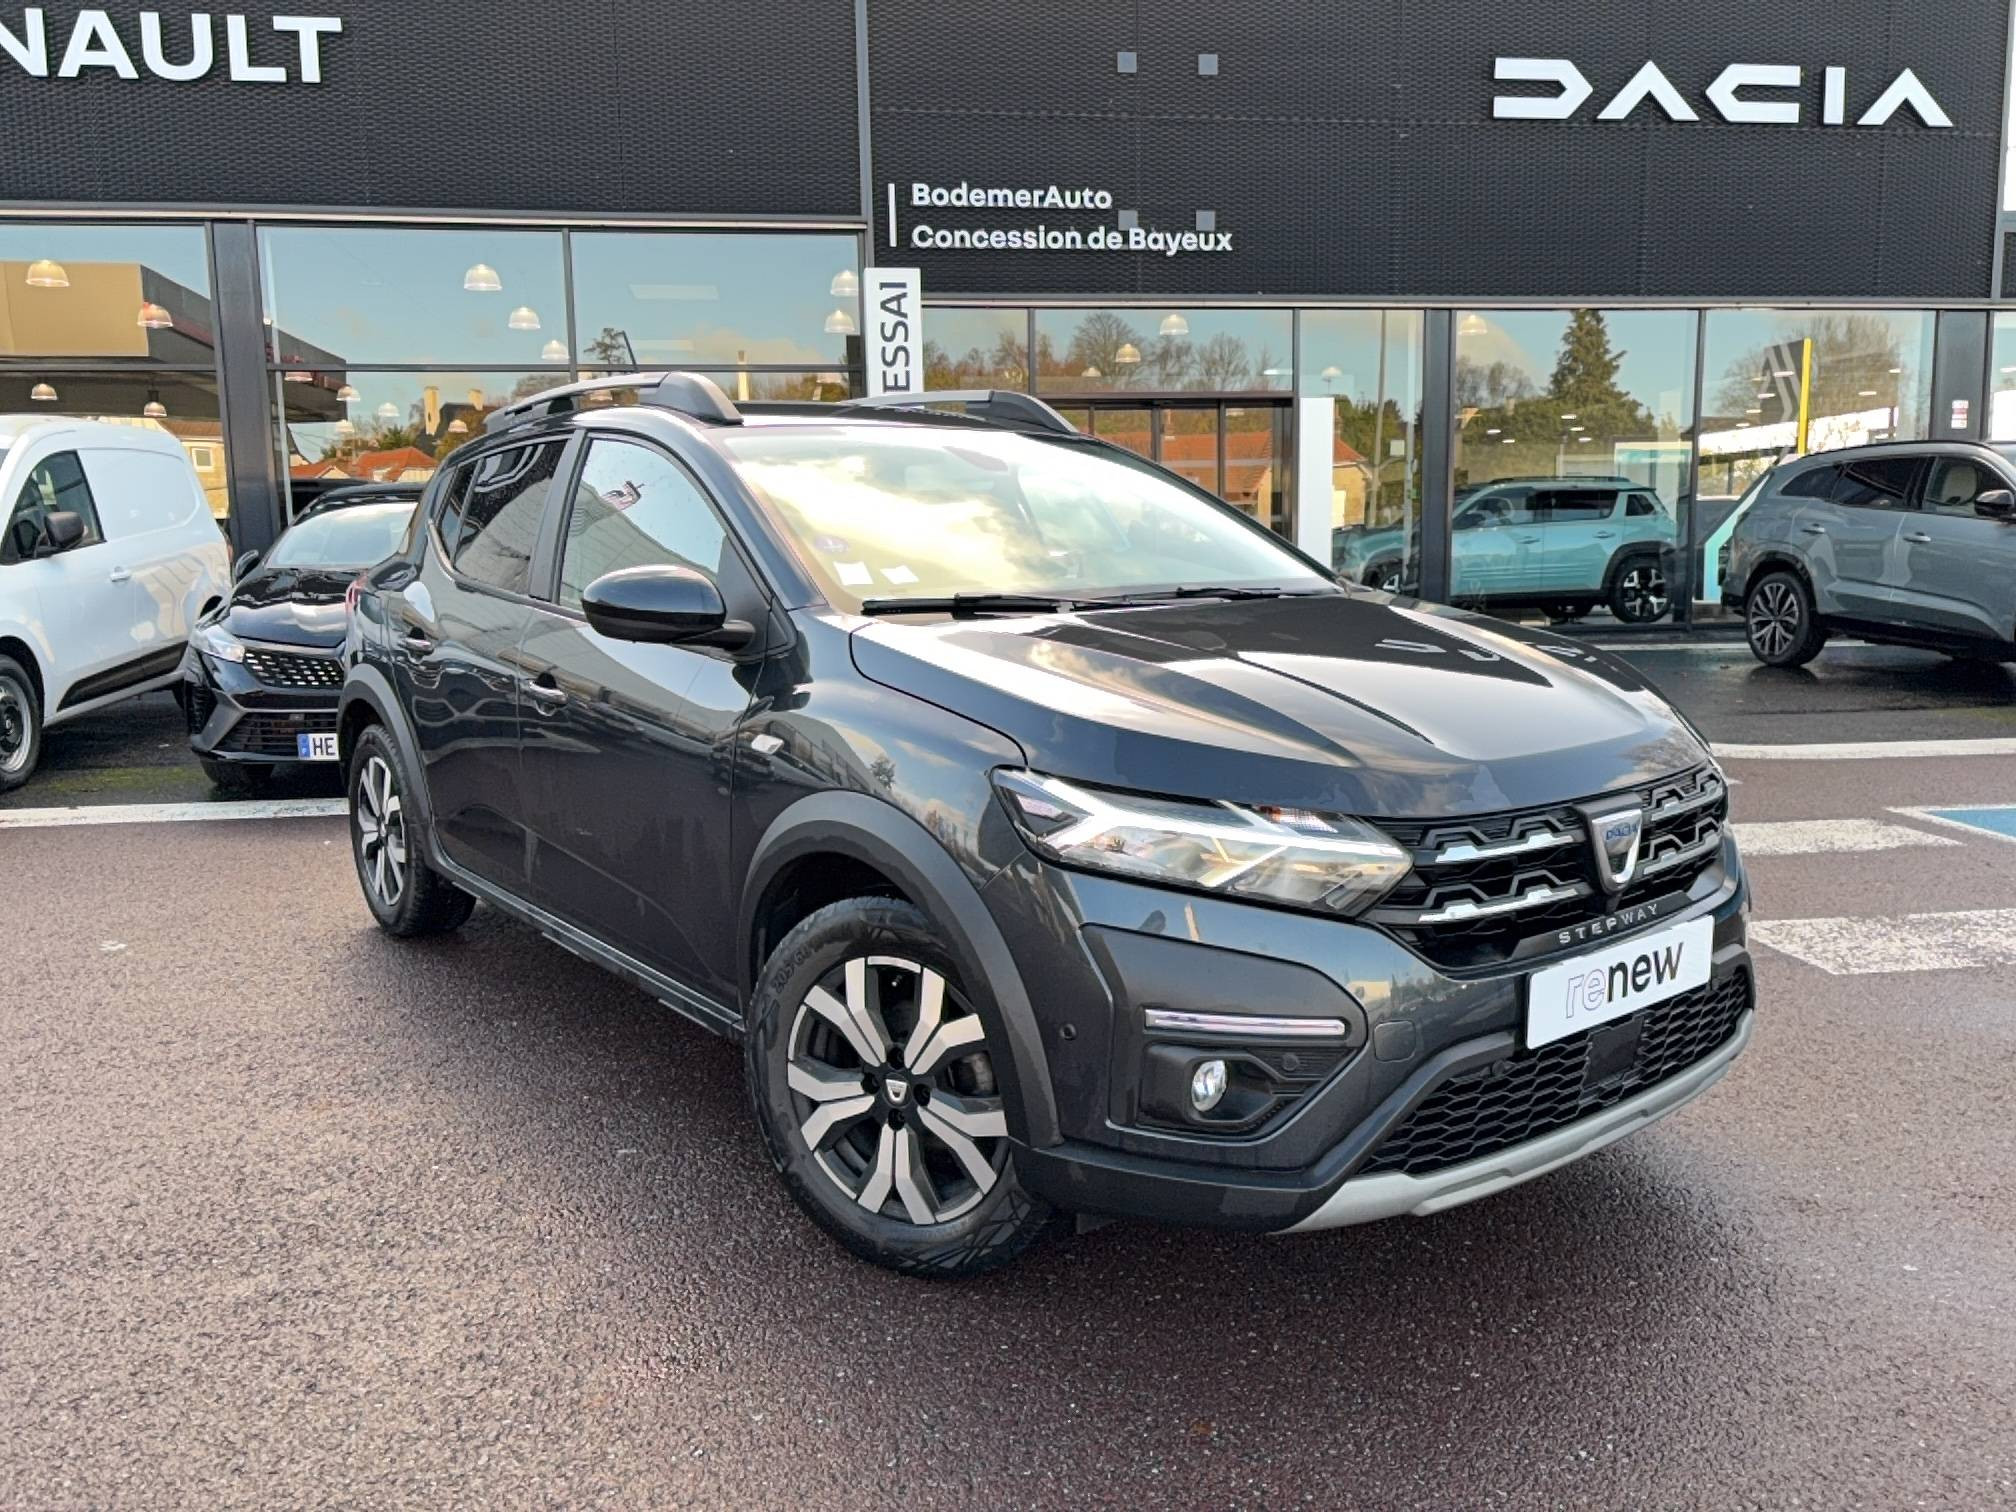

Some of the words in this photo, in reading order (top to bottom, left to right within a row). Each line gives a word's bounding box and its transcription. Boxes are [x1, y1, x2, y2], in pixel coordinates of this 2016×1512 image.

[1492, 57, 1954, 128] DACIA
[911, 182, 1113, 209] BodemerAuto
[911, 225, 1082, 249] Concession
[1087, 227, 1124, 249] de
[1128, 228, 1233, 256] Bayeux
[879, 282, 910, 393] ESSAI
[312, 737, 336, 756] HE
[1558, 904, 1658, 944] STEPWAY
[1566, 942, 1684, 1019] renew
